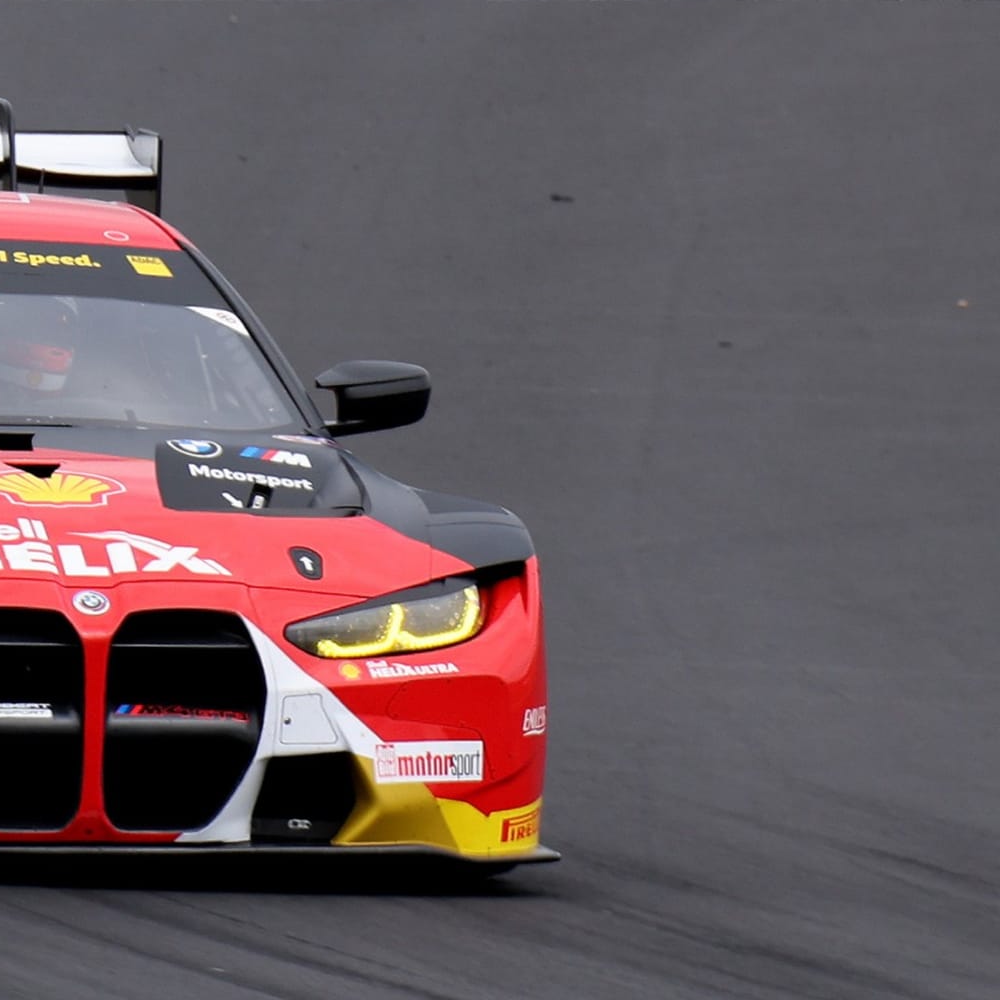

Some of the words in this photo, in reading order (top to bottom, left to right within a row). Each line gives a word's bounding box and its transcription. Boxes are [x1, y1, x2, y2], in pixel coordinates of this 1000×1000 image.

[13, 251, 102, 268] Speed.
[187, 463, 314, 491] Motorsport
[413, 662, 460, 676] ULTRA
